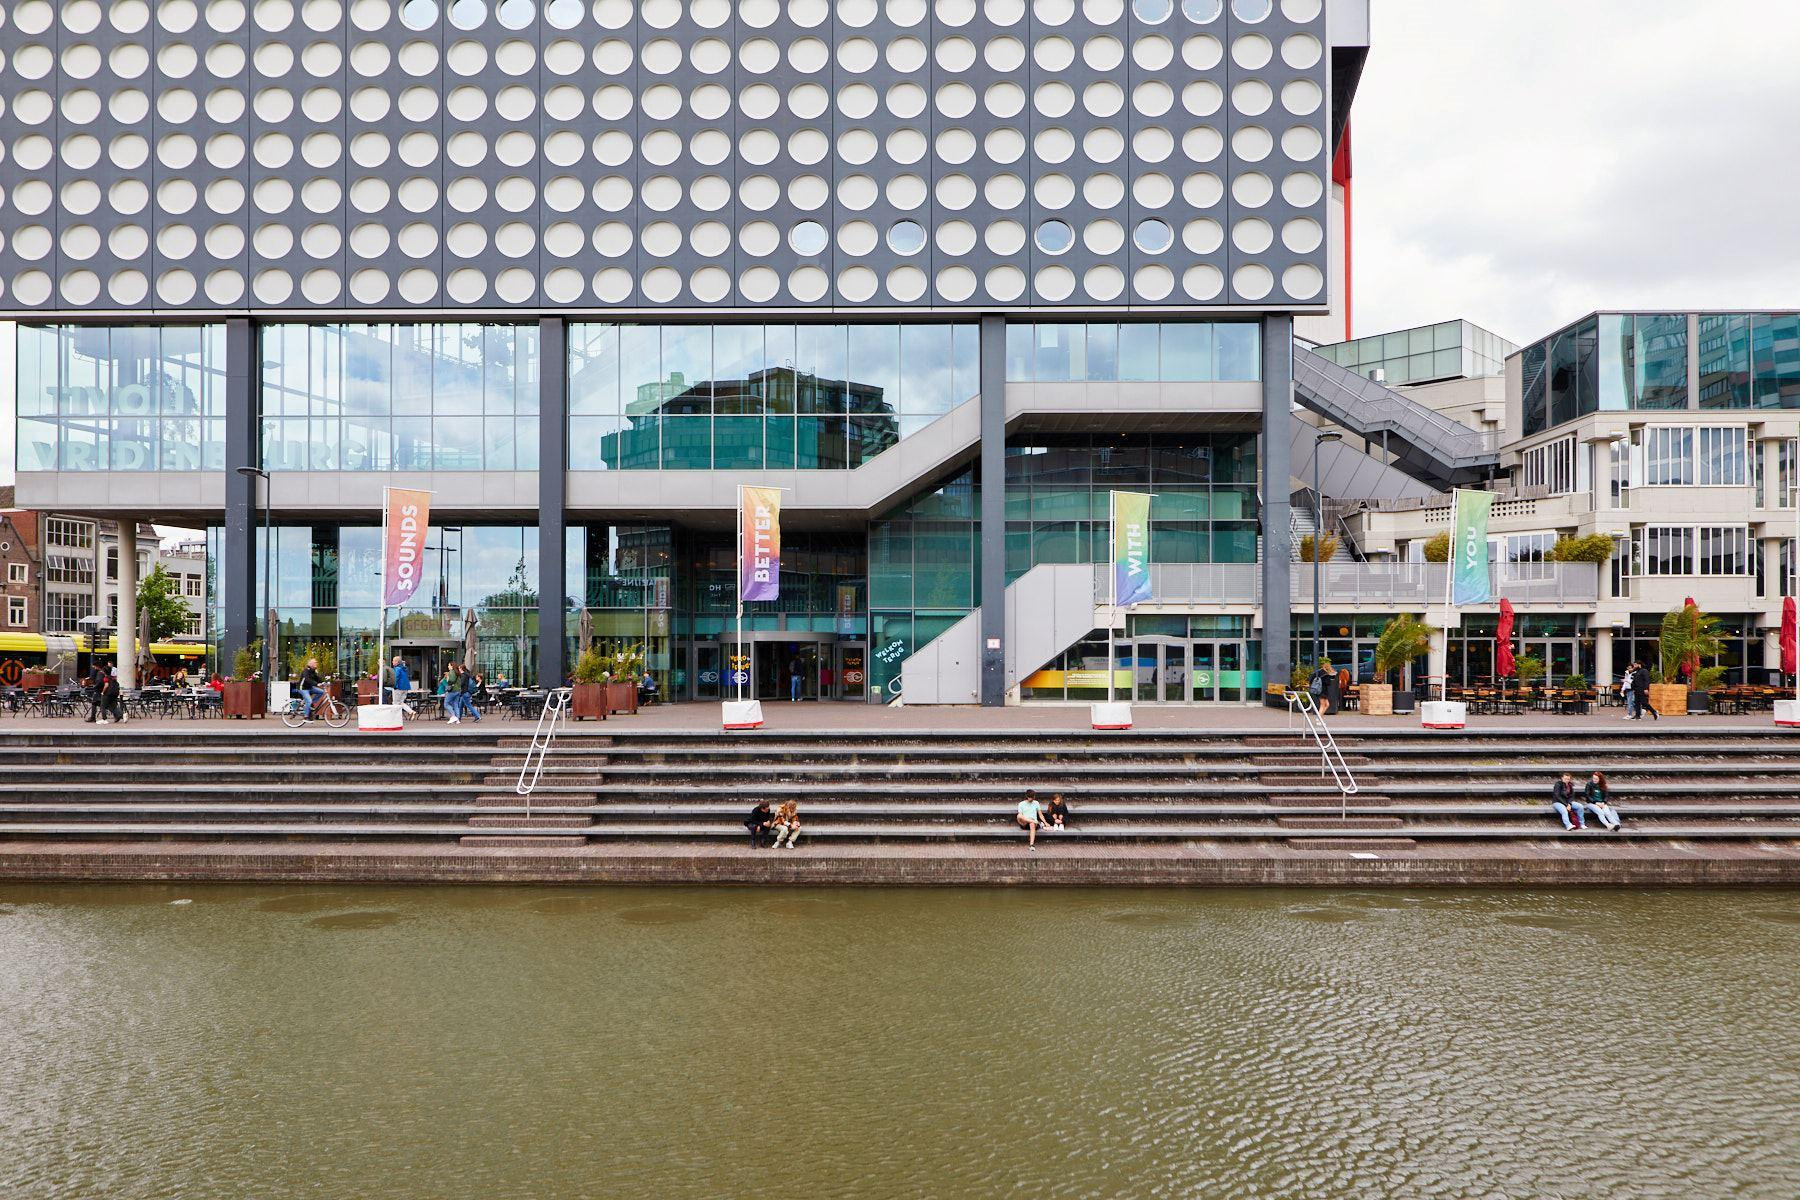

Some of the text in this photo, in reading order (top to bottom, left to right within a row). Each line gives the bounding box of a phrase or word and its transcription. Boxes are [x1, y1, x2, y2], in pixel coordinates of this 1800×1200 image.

[397, 504, 418, 591] SOUNDS
[754, 505, 771, 582] BETTER
[1126, 523, 1142, 577] WITH
[1465, 526, 1478, 570] YOU
[875, 639, 903, 659] WELKOM
[882, 646, 905, 663] TERUG
